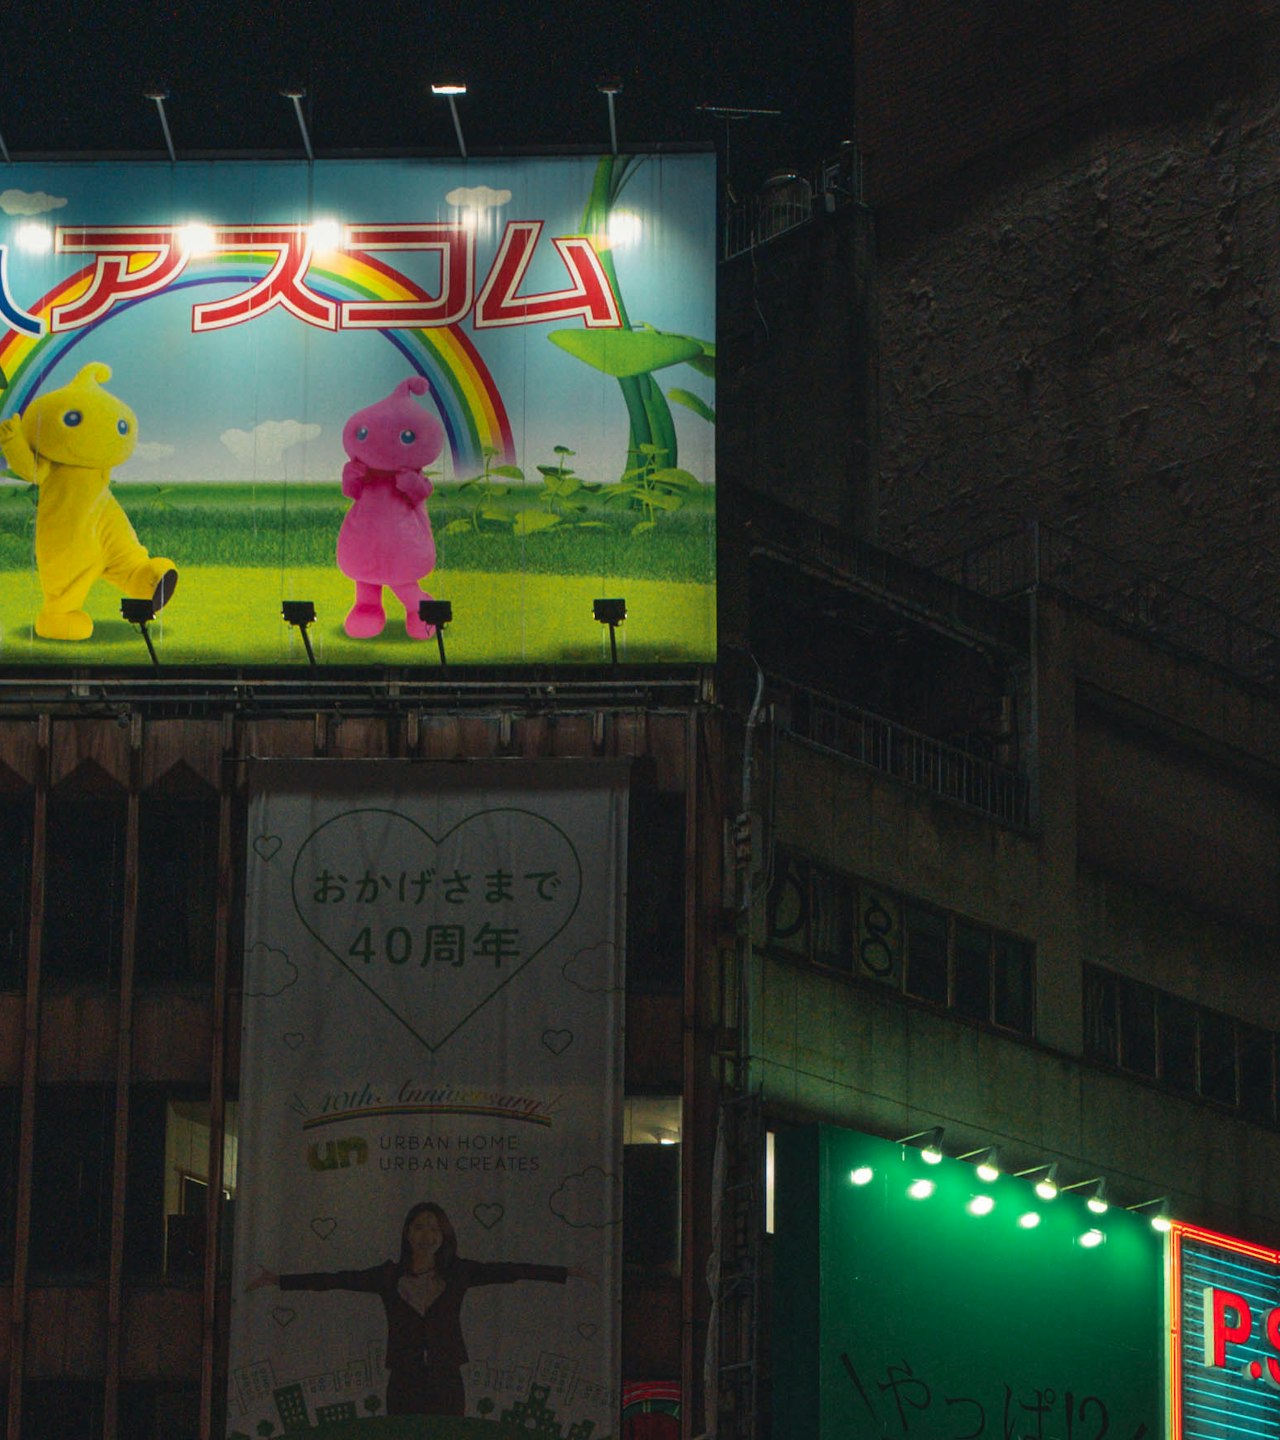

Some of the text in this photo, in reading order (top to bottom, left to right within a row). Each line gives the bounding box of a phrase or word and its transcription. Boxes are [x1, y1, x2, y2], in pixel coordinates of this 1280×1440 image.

[313, 868, 560, 905] おかげさまで
[348, 923, 520, 969] 40周年
[379, 1135, 519, 1151] URBAN HOME
[379, 1156, 540, 1172] URBAN CREATES
